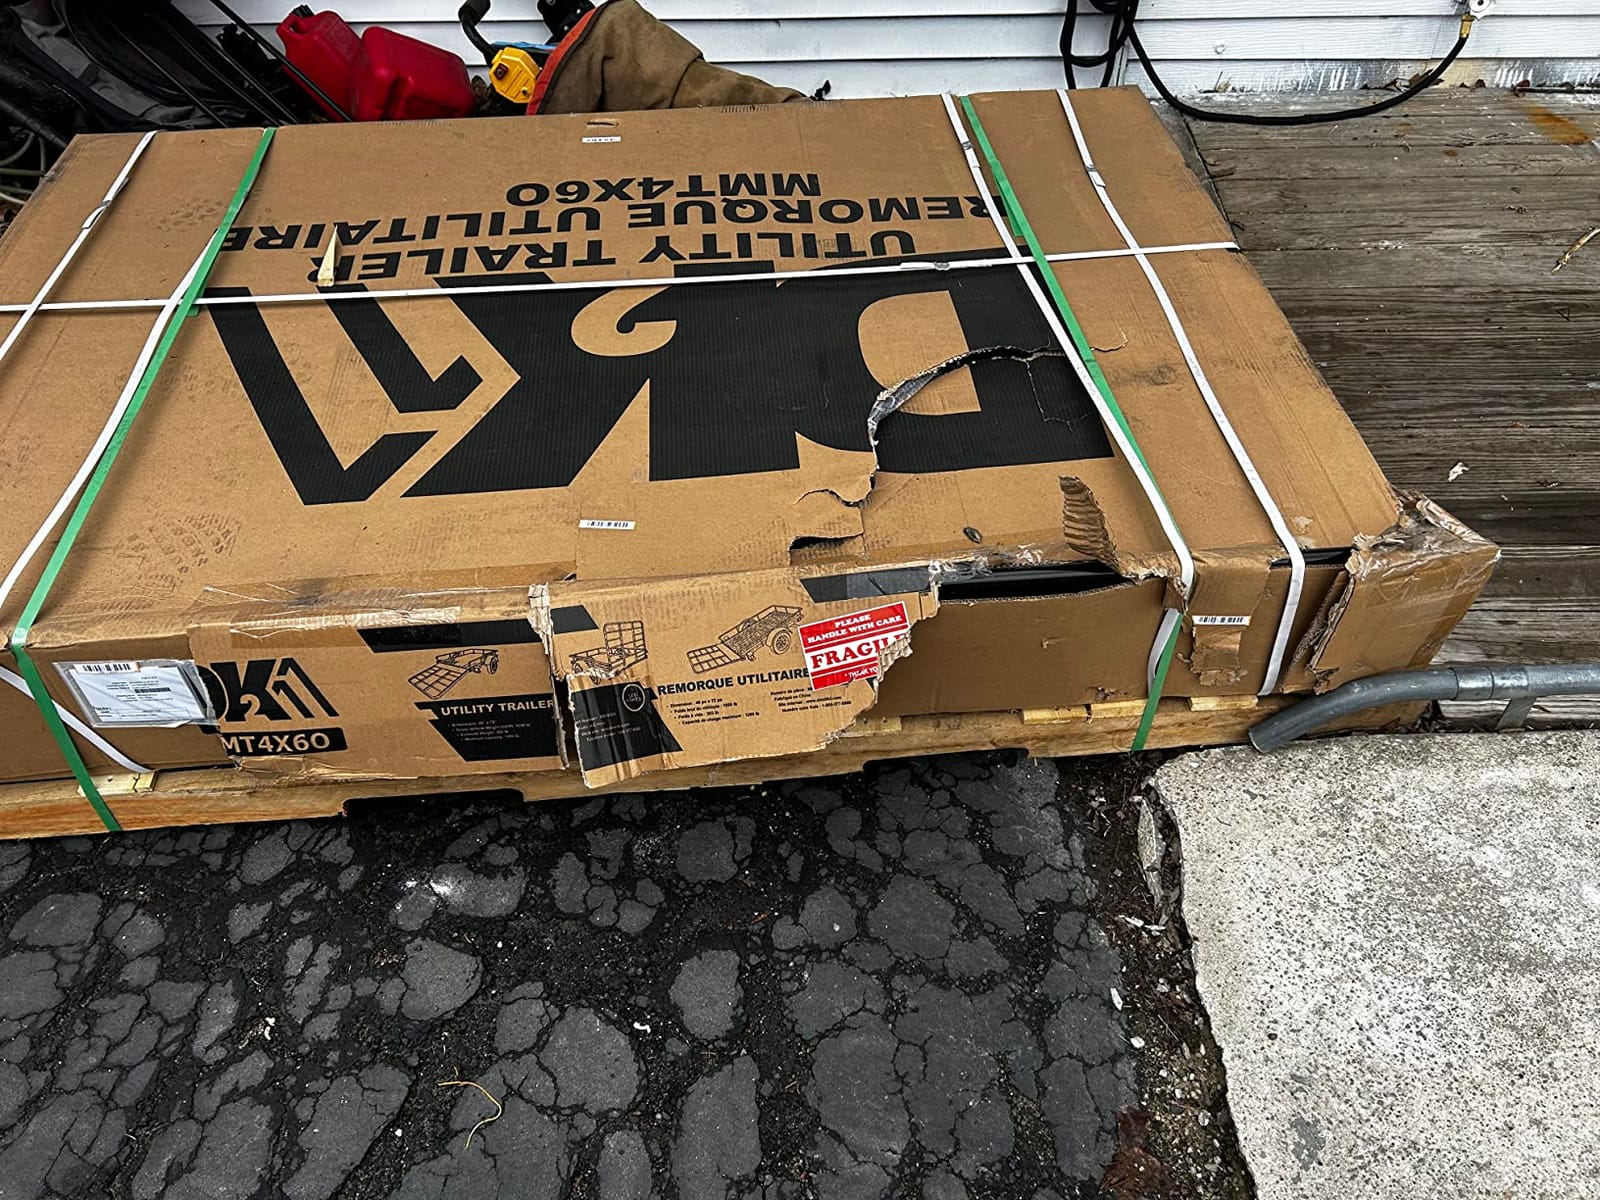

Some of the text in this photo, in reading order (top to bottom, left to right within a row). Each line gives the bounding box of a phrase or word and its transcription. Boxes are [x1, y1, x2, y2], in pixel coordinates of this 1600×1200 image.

[221, 195, 1006, 252] REMORQUE UTILITAIRE
[307, 230, 916, 283] UTILITY TRAILER
[807, 615, 903, 644] HANDLE WITH CARE
[834, 614, 871, 628] PLEASE
[657, 667, 810, 696] REMORQUE UTILITAIRE
[441, 700, 554, 716] UTILITY TRAILER
